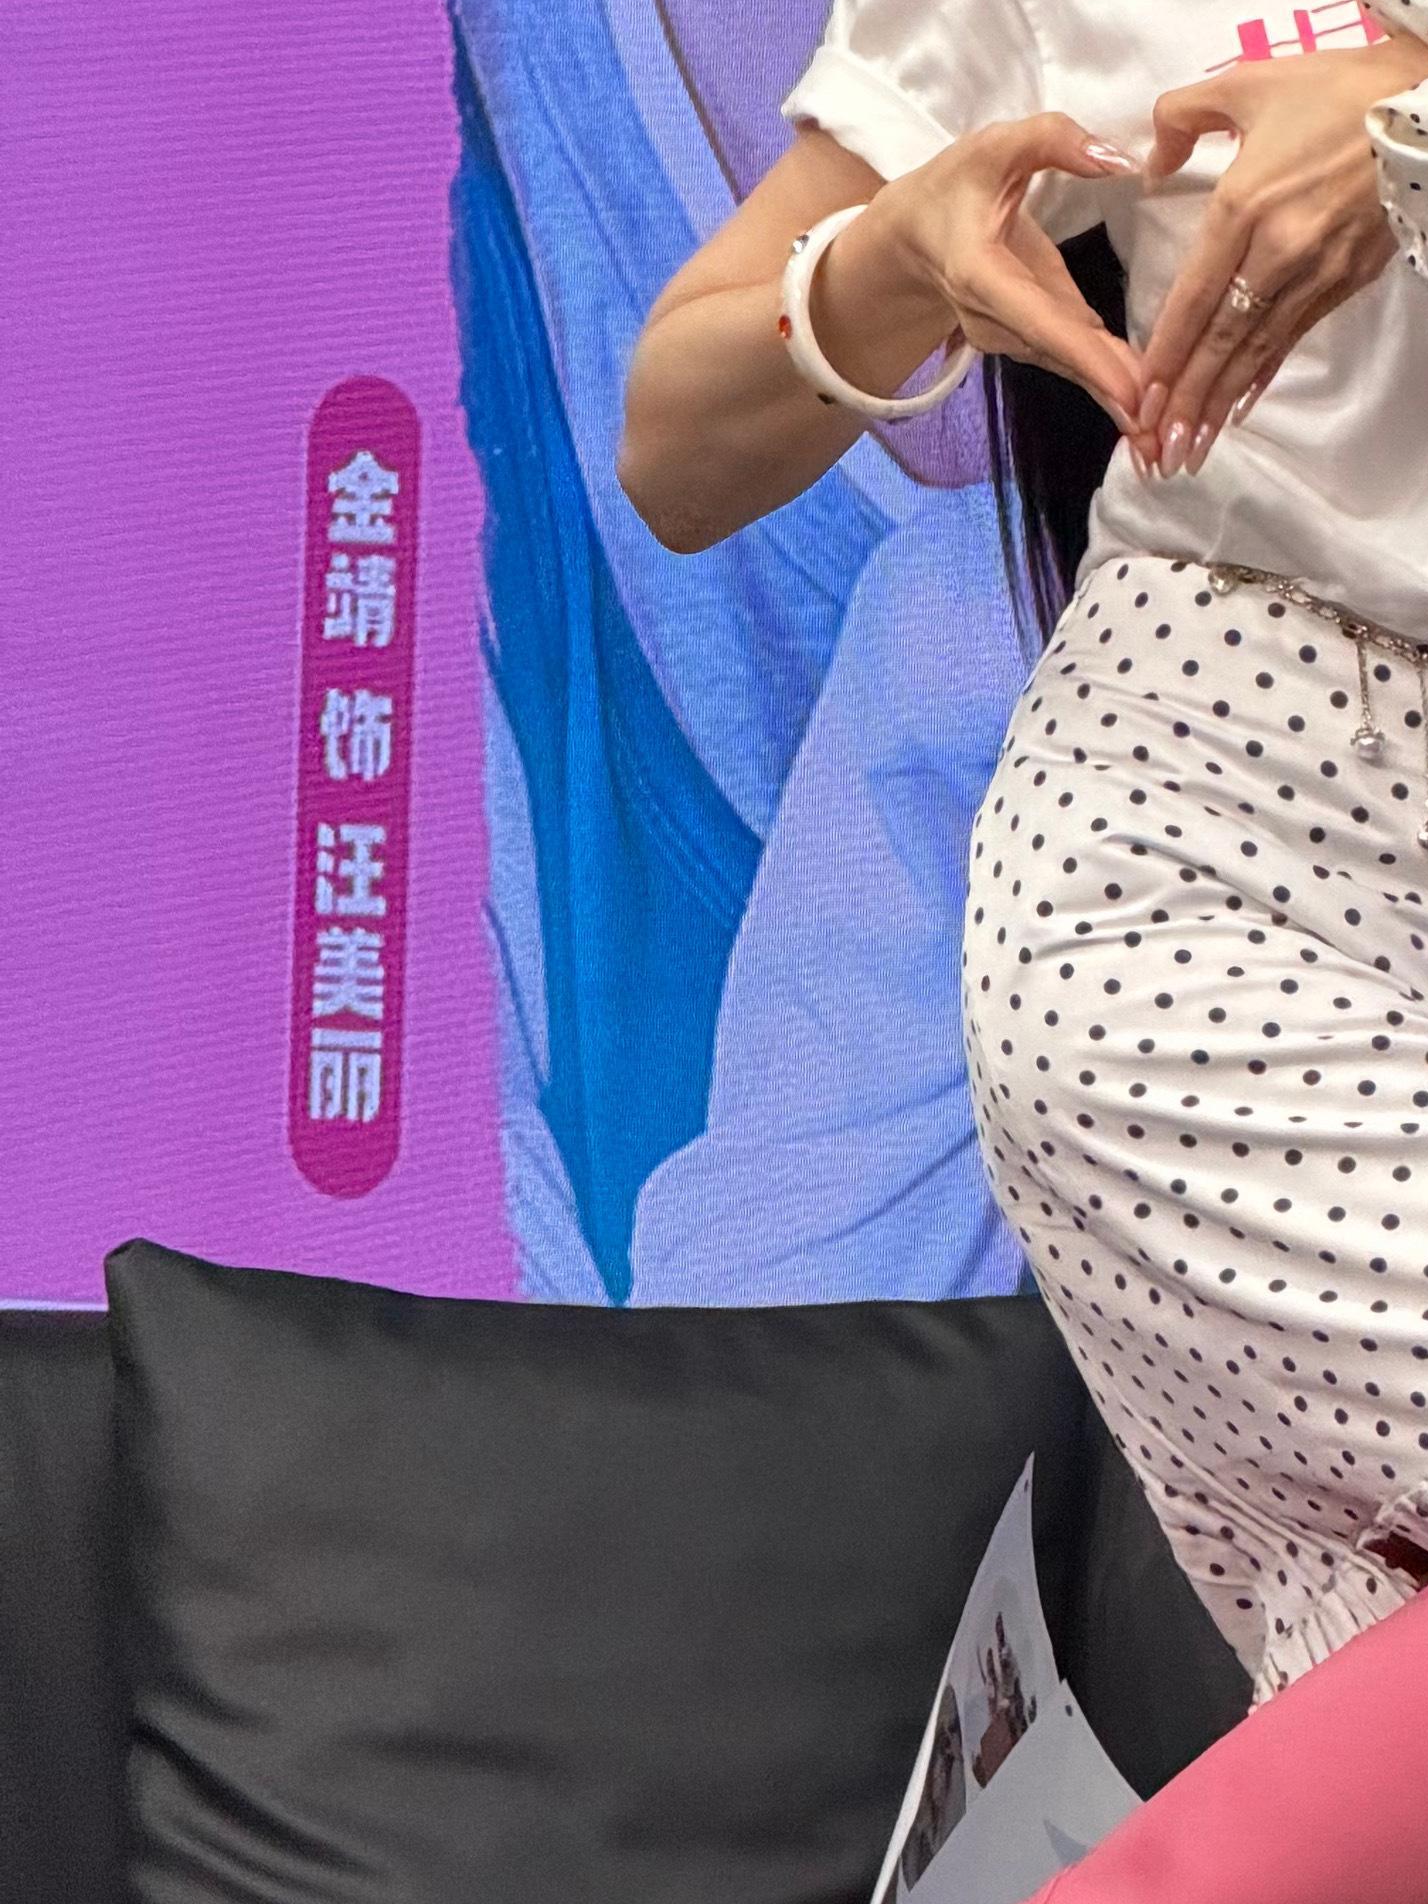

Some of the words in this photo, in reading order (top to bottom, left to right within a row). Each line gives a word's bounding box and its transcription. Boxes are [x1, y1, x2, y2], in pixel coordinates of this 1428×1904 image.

[323, 450, 400, 647] 金靖
[320, 687, 393, 781] 饰
[309, 821, 387, 1122] 汪美丽
